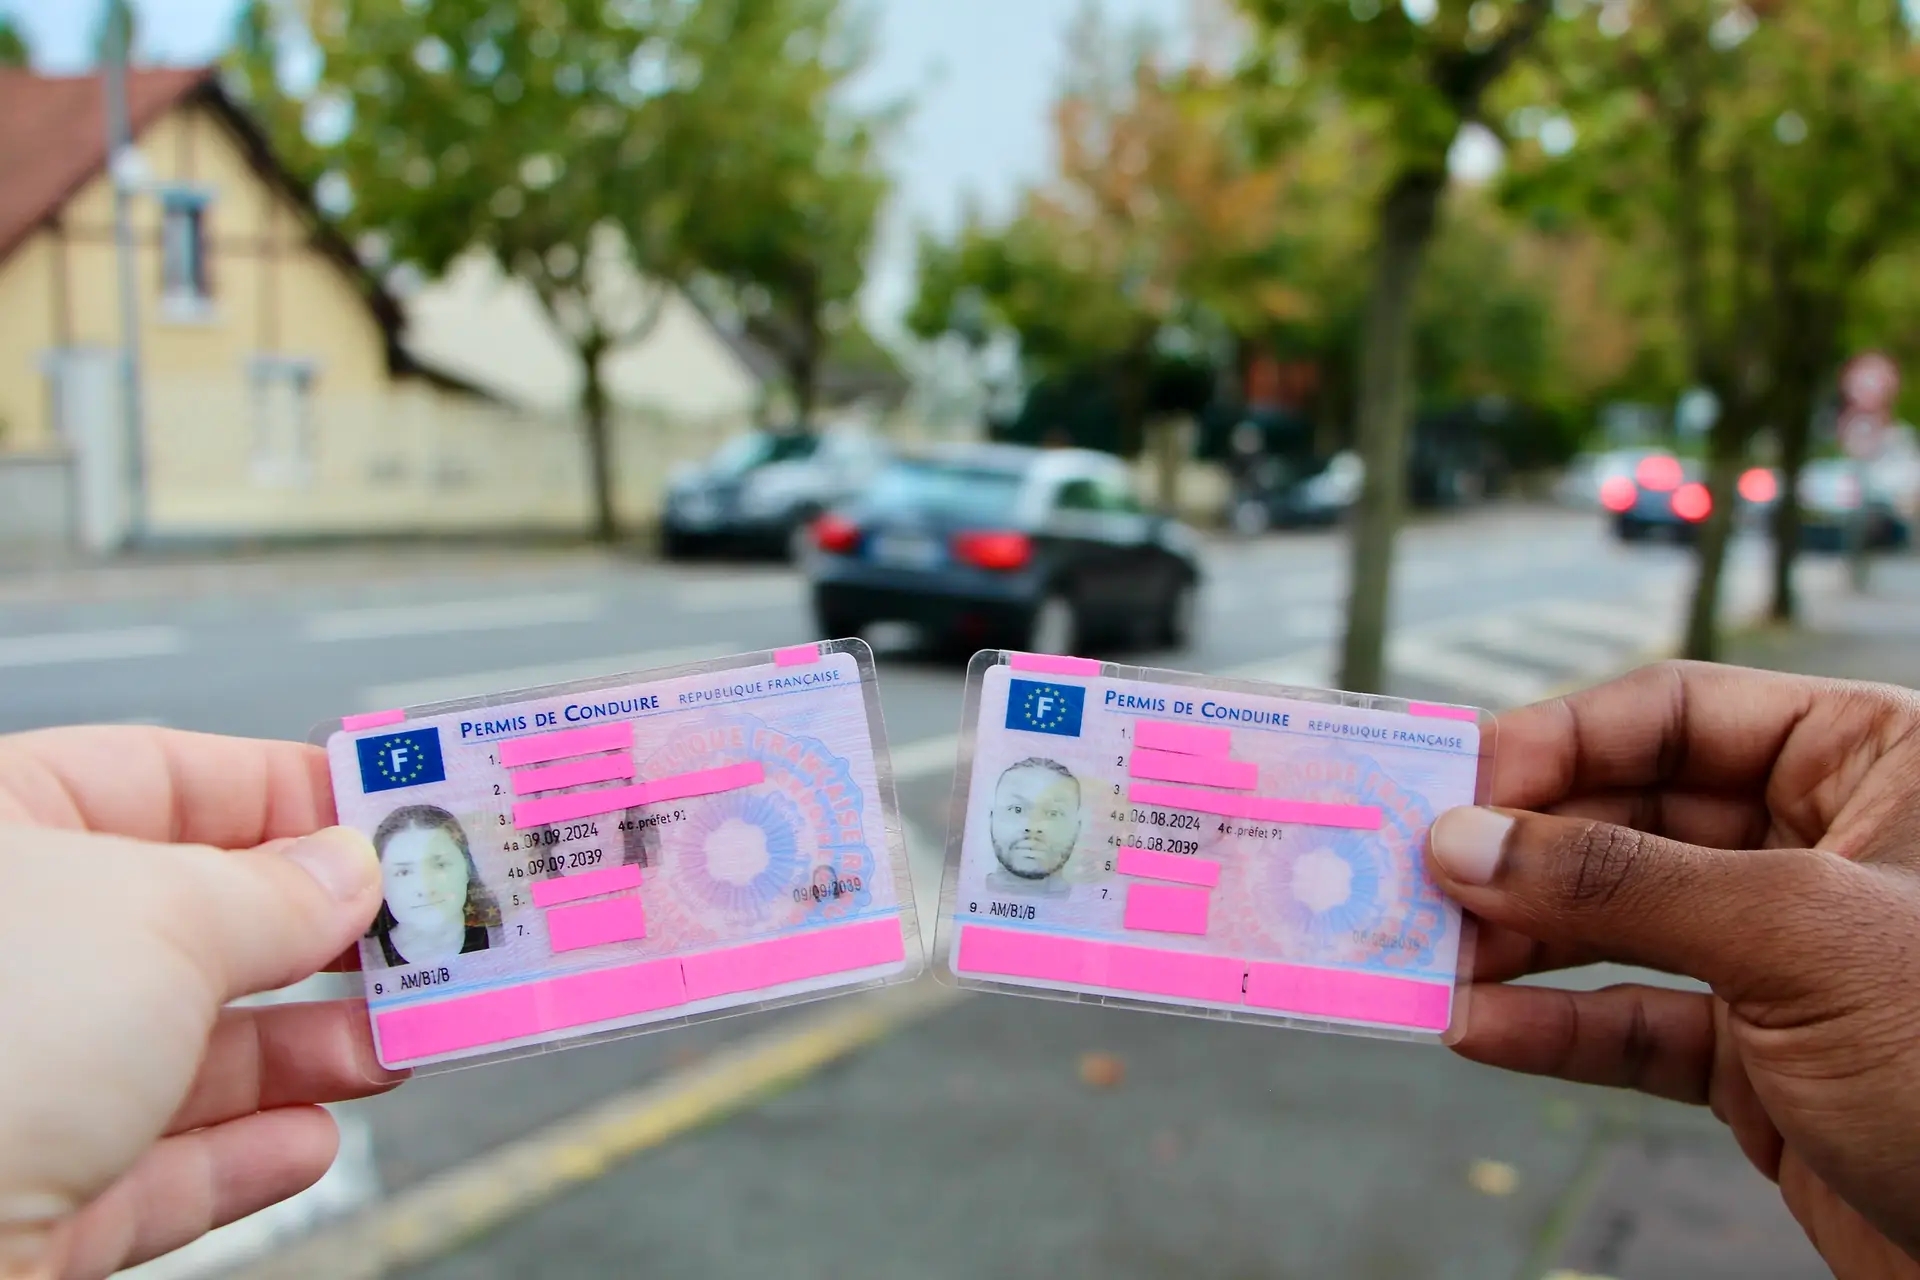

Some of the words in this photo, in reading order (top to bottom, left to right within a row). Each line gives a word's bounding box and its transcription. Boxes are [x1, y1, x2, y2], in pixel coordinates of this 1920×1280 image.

[461, 716, 526, 738] PERMIS
[535, 711, 557, 727] DE
[564, 695, 660, 722] CONDUIRE
[1036, 696, 1054, 718] F
[1105, 690, 1165, 711] PERMIS
[1174, 701, 1193, 715] DE
[1201, 702, 1290, 727] CONDUIRE
[391, 748, 408, 772] F
[989, 902, 1036, 920] AM/B1/B
[400, 967, 450, 990] AM/B1/B
